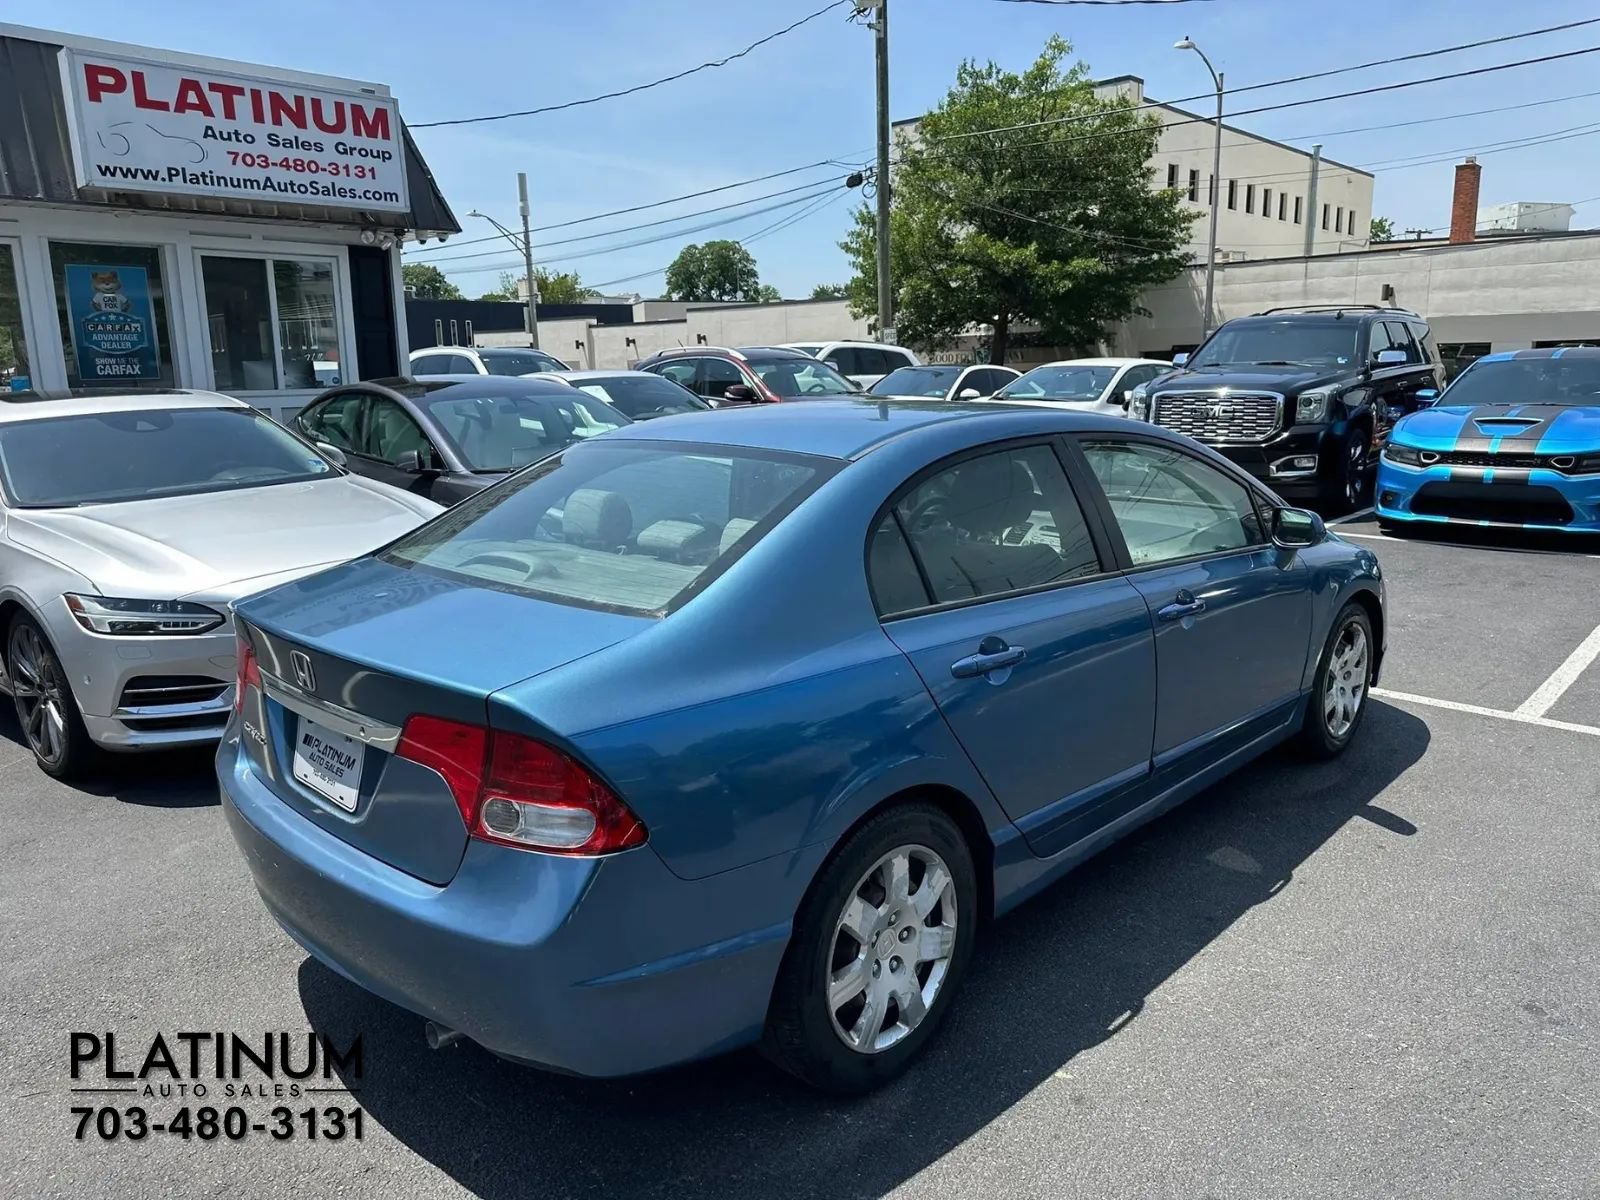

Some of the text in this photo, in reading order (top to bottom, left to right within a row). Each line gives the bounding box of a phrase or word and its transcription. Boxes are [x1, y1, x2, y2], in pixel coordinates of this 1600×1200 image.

[84, 64, 391, 141] PLATINUM
[203, 125, 393, 163] Auto Sales Group
[227, 150, 377, 181] 703-480-3131
[97, 163, 399, 204] www.PlatinumAutoSales.com
[87, 323, 141, 332] CARFAX
[92, 333, 139, 342] ADVANTAGE
[101, 342, 132, 350] DEALER
[95, 357, 117, 365] SHOW
[96, 364, 141, 376] CARFAX
[309, 752, 323, 766] AUTO
[325, 762, 345, 778] SALES
[312, 738, 357, 770] PLATINUM
